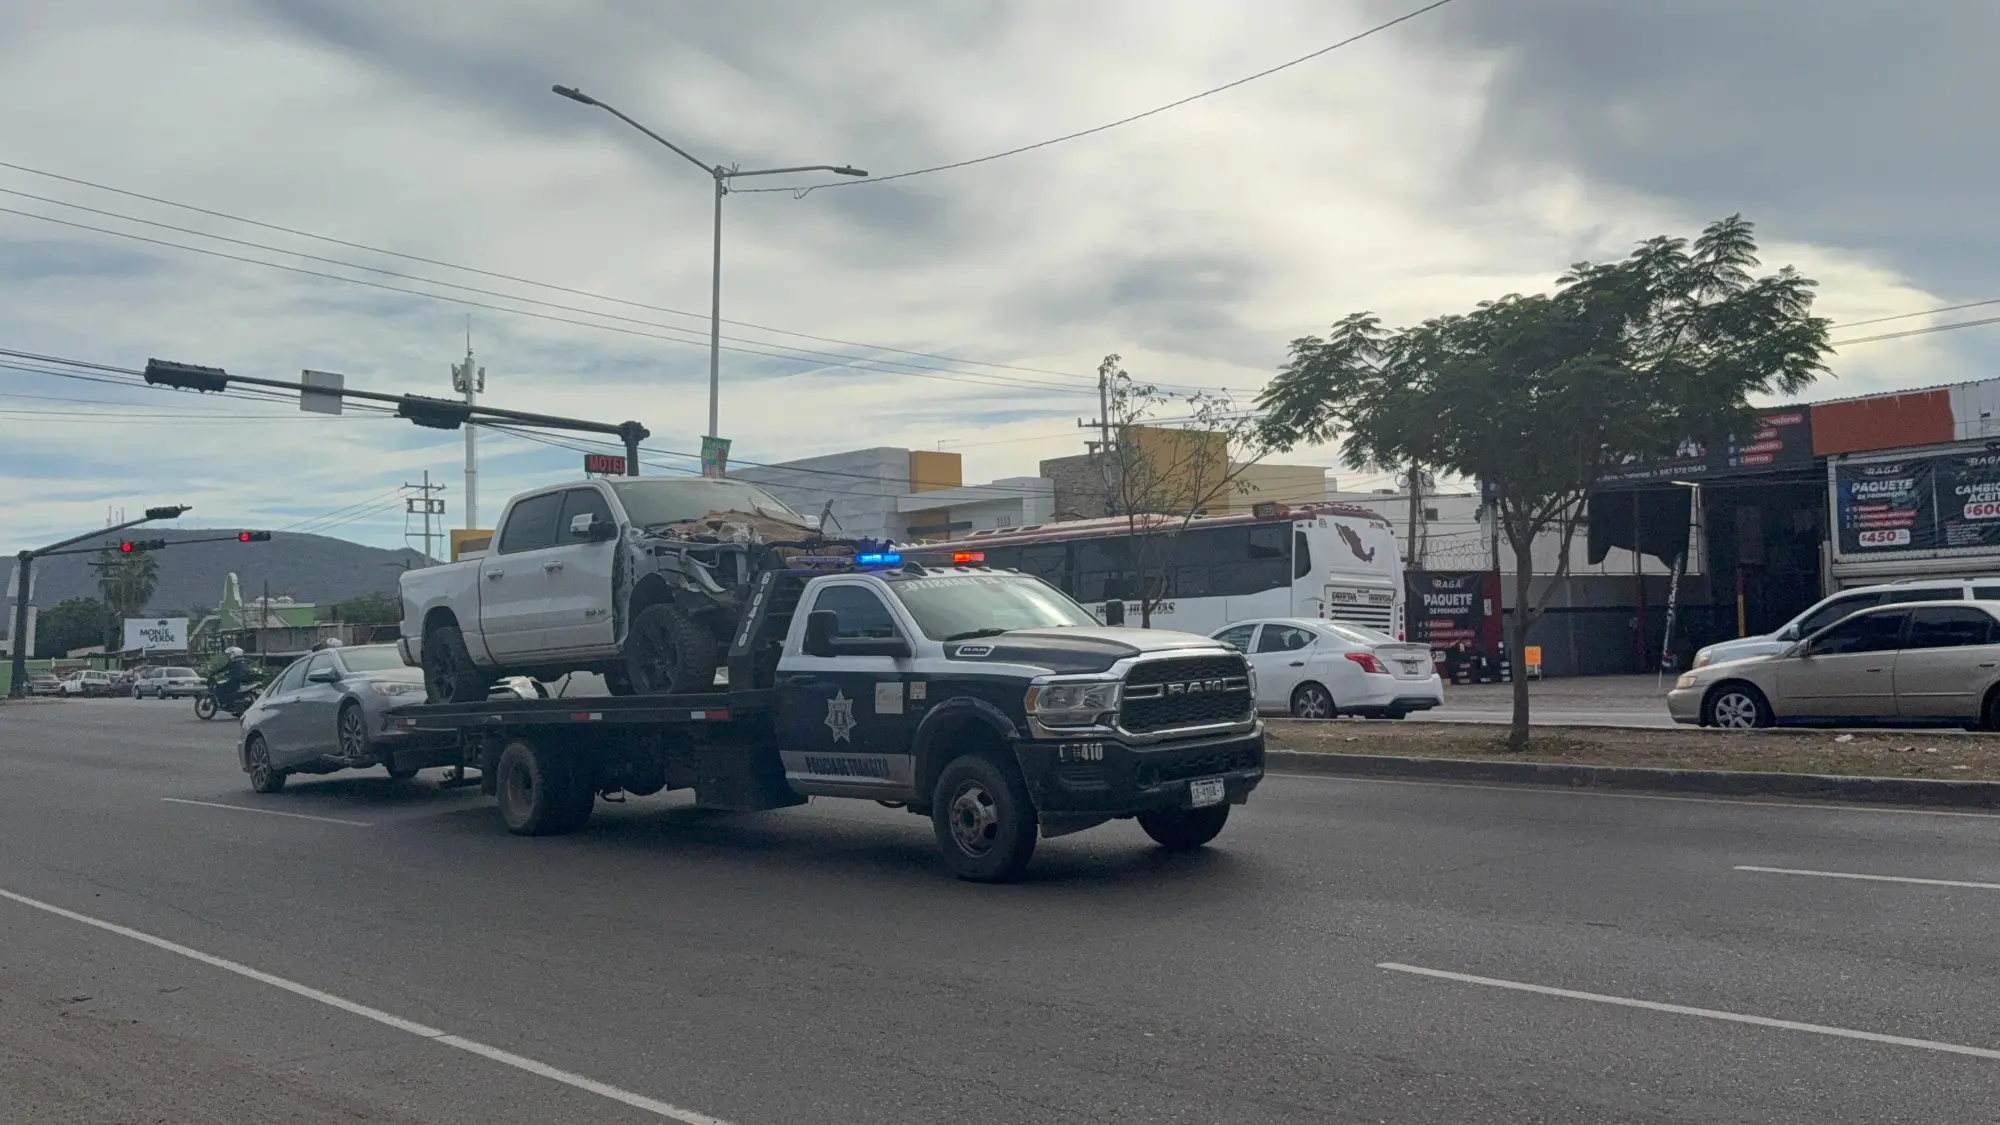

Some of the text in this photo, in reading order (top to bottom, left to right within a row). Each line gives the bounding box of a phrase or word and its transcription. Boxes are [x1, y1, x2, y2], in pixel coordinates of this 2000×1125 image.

[589, 456, 625, 473] MOTEL
[1867, 465, 1899, 475] RAGA
[1852, 478, 1914, 493] PAQUETE
[1861, 531, 1897, 543] $450
[1436, 580, 1462, 589] RAGA
[1423, 593, 1473, 606] PAQUETE
[1167, 679, 1224, 696] RAM
